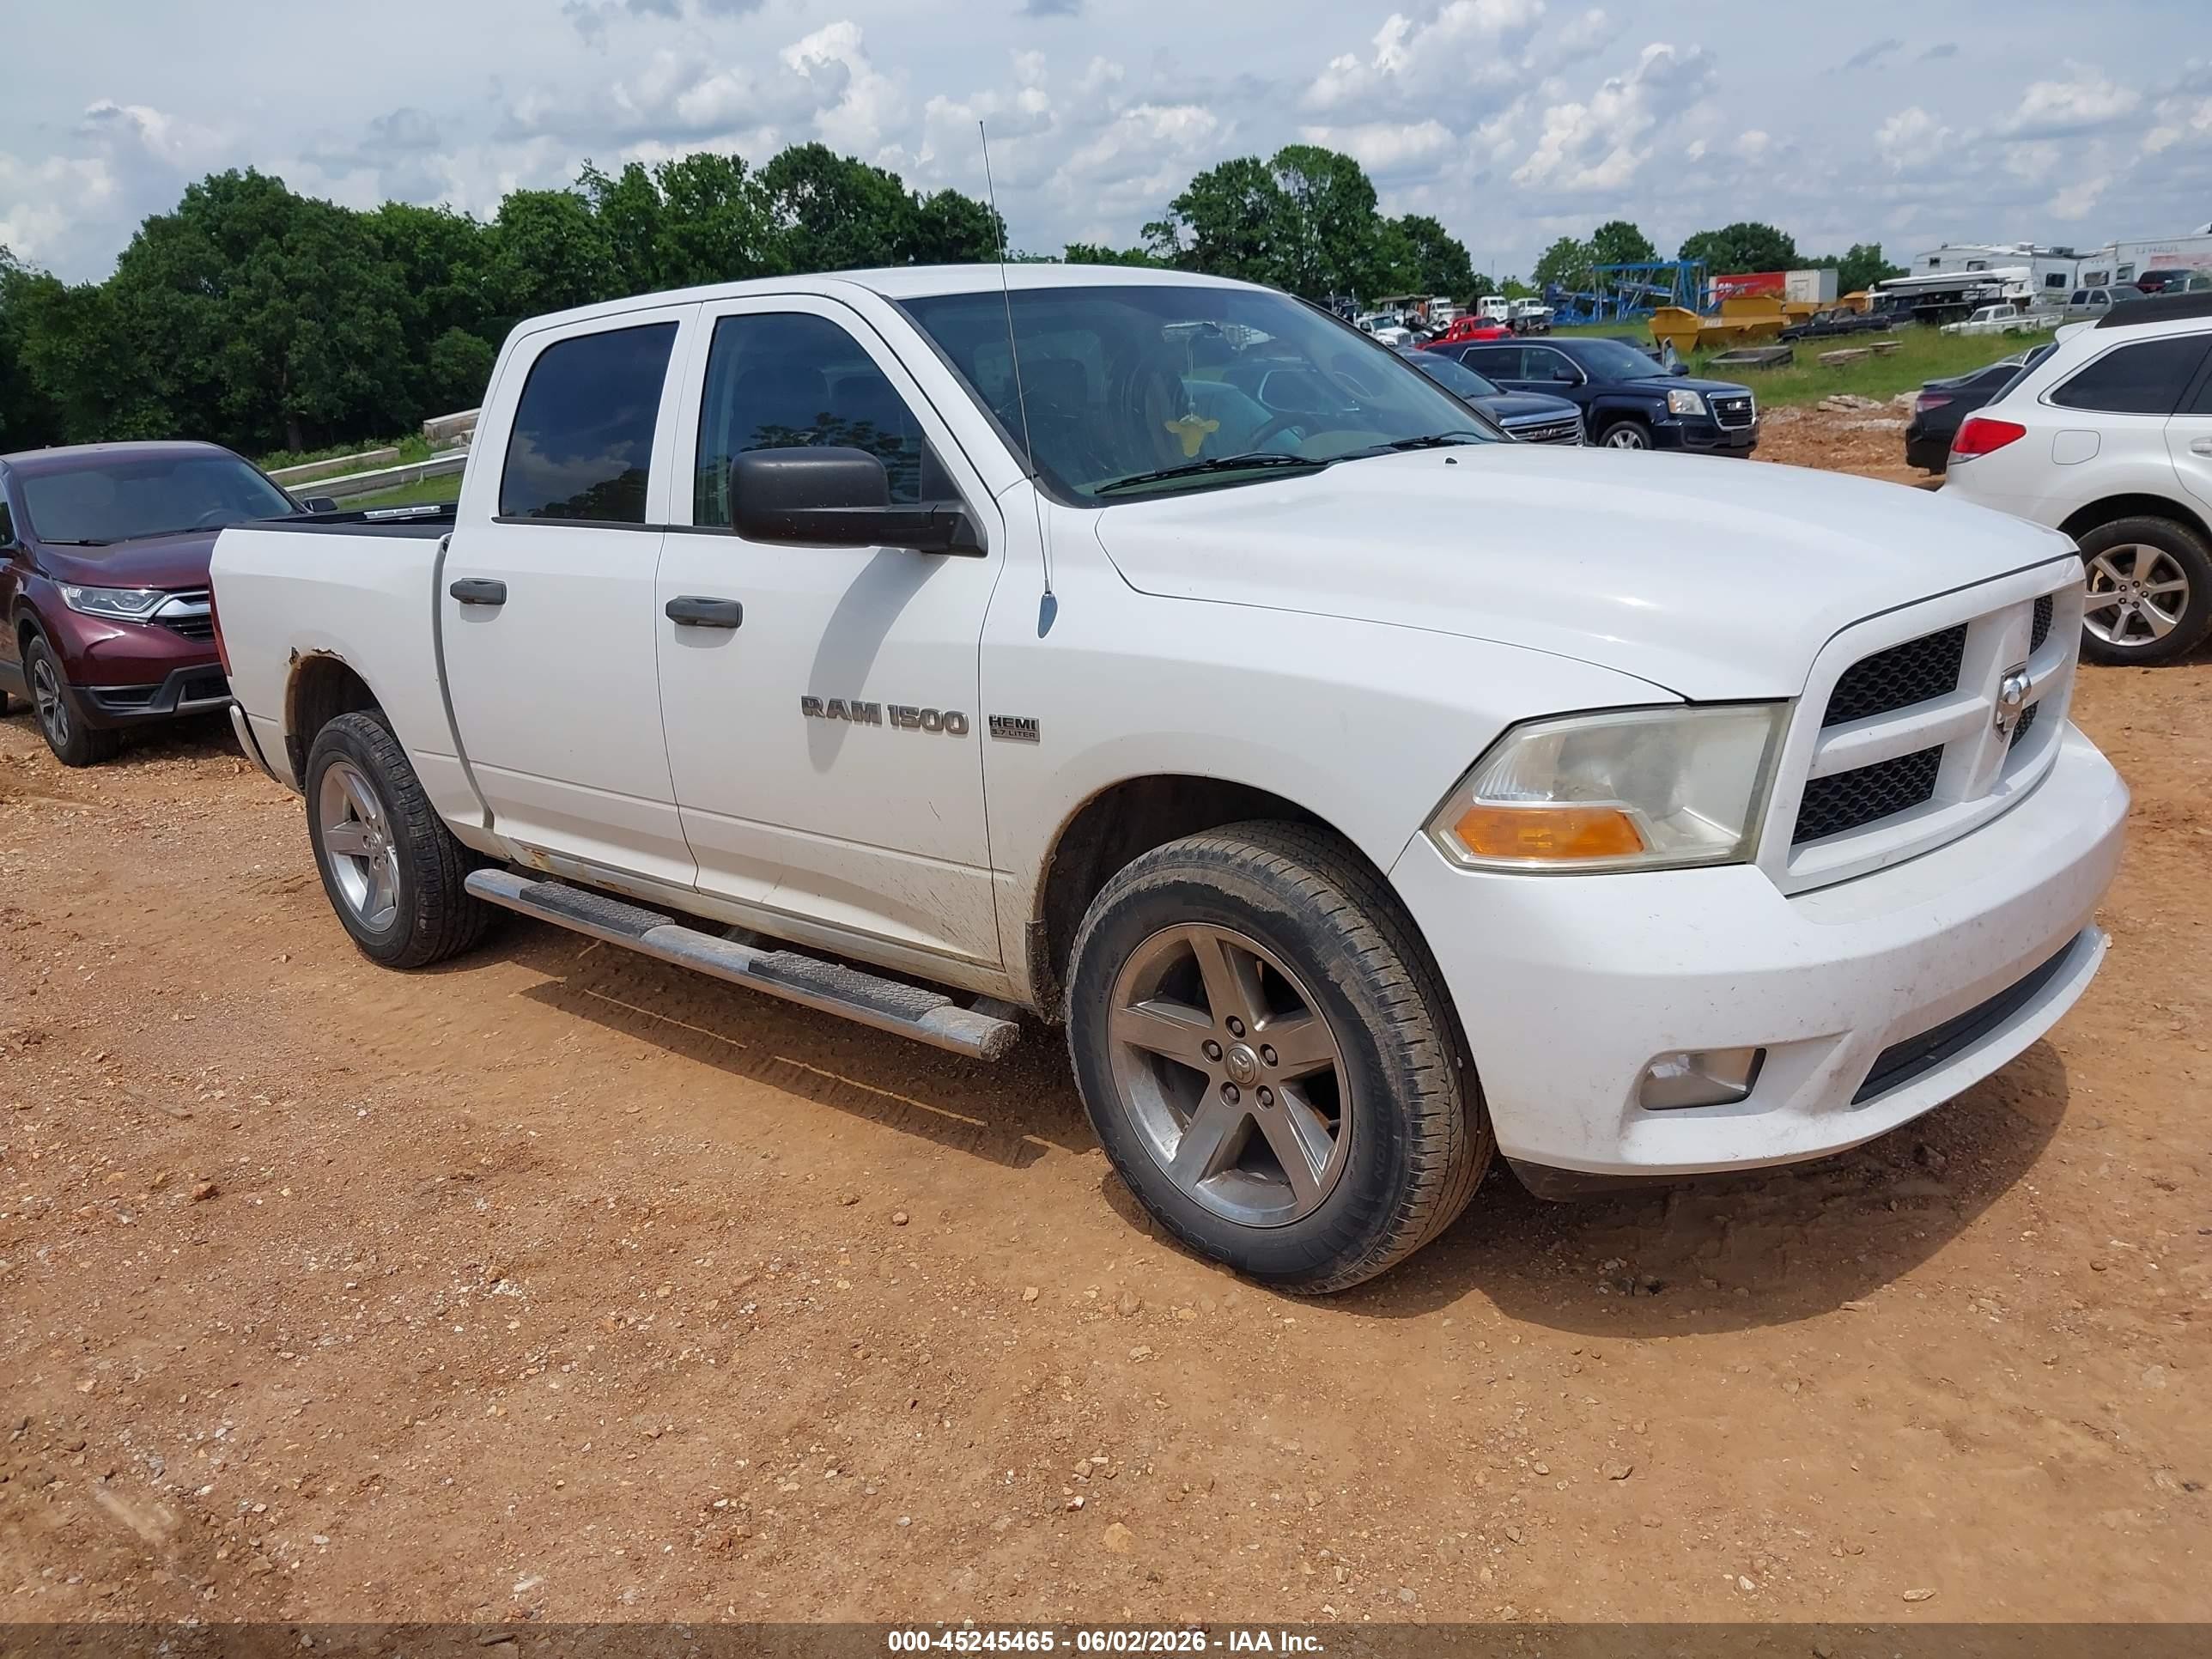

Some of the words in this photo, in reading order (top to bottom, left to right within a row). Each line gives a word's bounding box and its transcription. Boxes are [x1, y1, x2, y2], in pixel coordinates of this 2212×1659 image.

[801, 696, 883, 725] RAM
[887, 704, 969, 734] 1500
[988, 714, 1036, 730] HEMI
[1008, 729, 1036, 738] LITER
